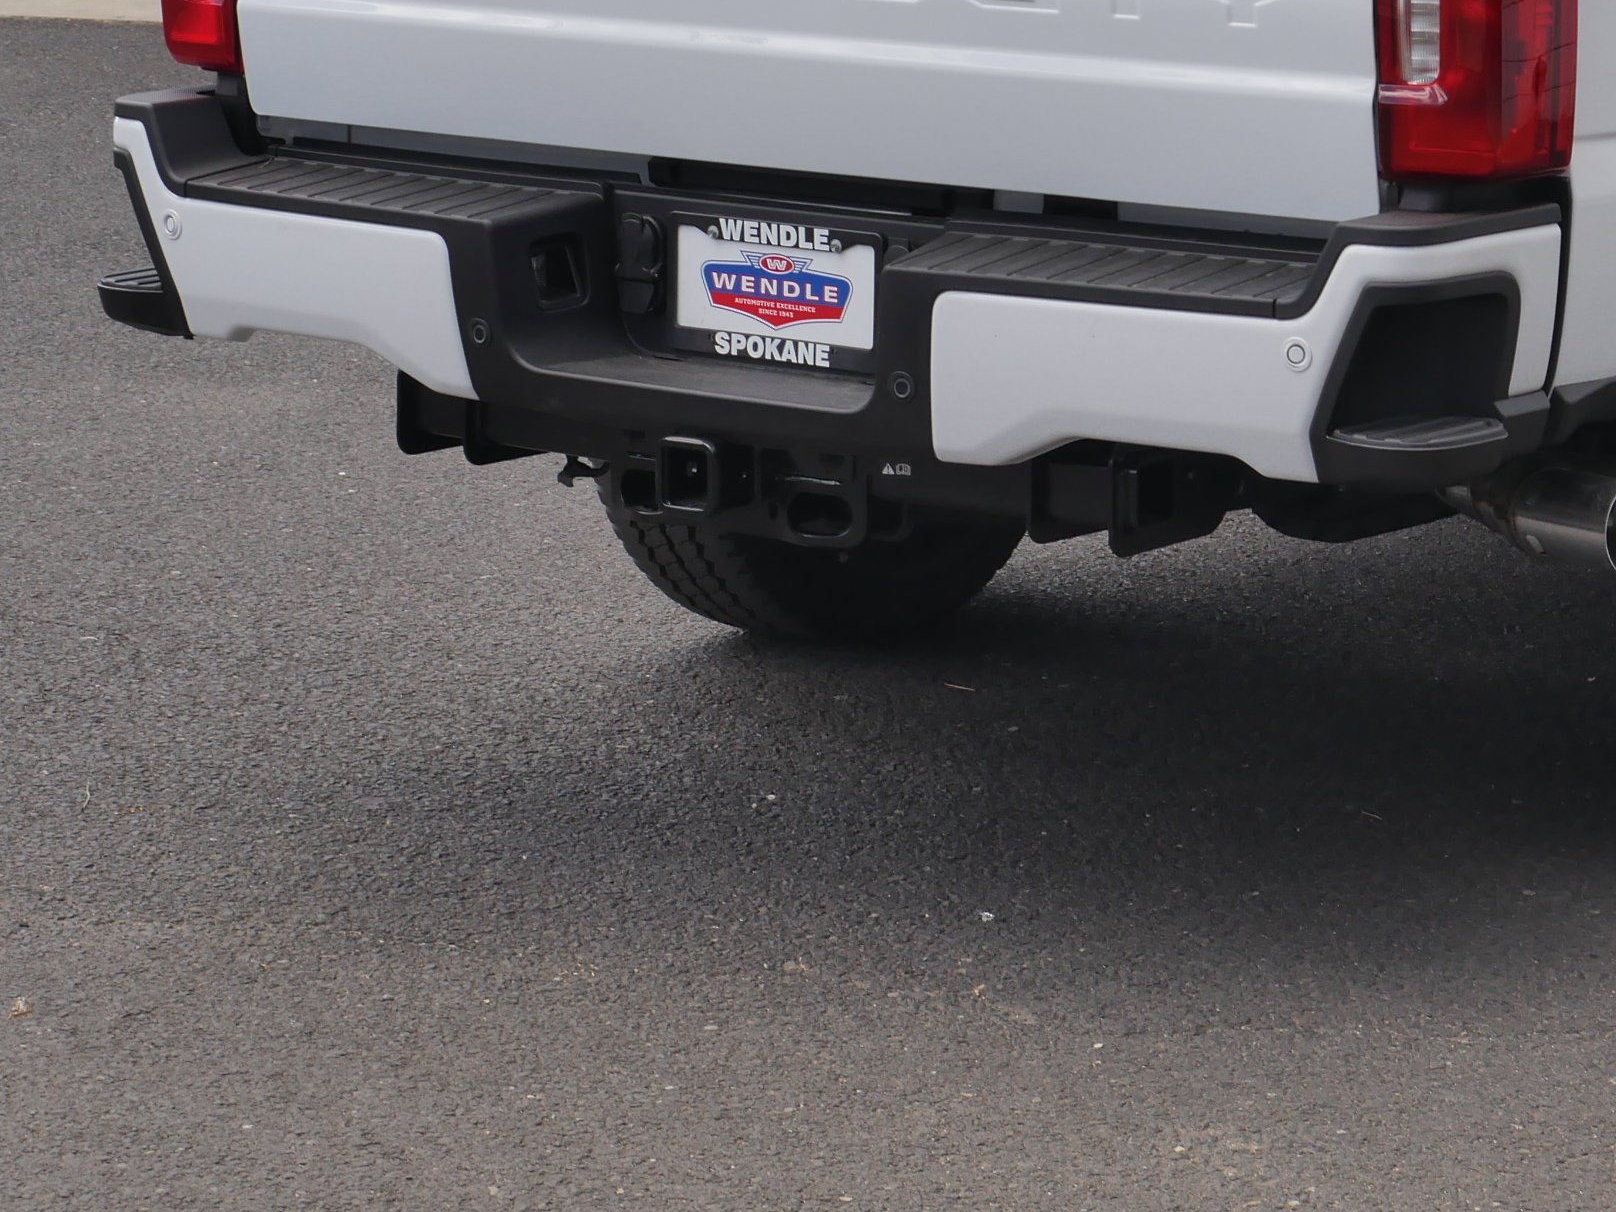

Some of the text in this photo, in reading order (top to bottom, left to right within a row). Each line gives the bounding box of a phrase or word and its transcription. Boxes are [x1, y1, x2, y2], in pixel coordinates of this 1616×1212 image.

[719, 217, 831, 252] WENDLE
[766, 258, 788, 271] W
[712, 271, 839, 303] WENDLE
[734, 297, 816, 313] AUTOMOTIVE EXCELLENCE
[758, 308, 778, 316] SINCE
[714, 331, 830, 368] SPOKANE
